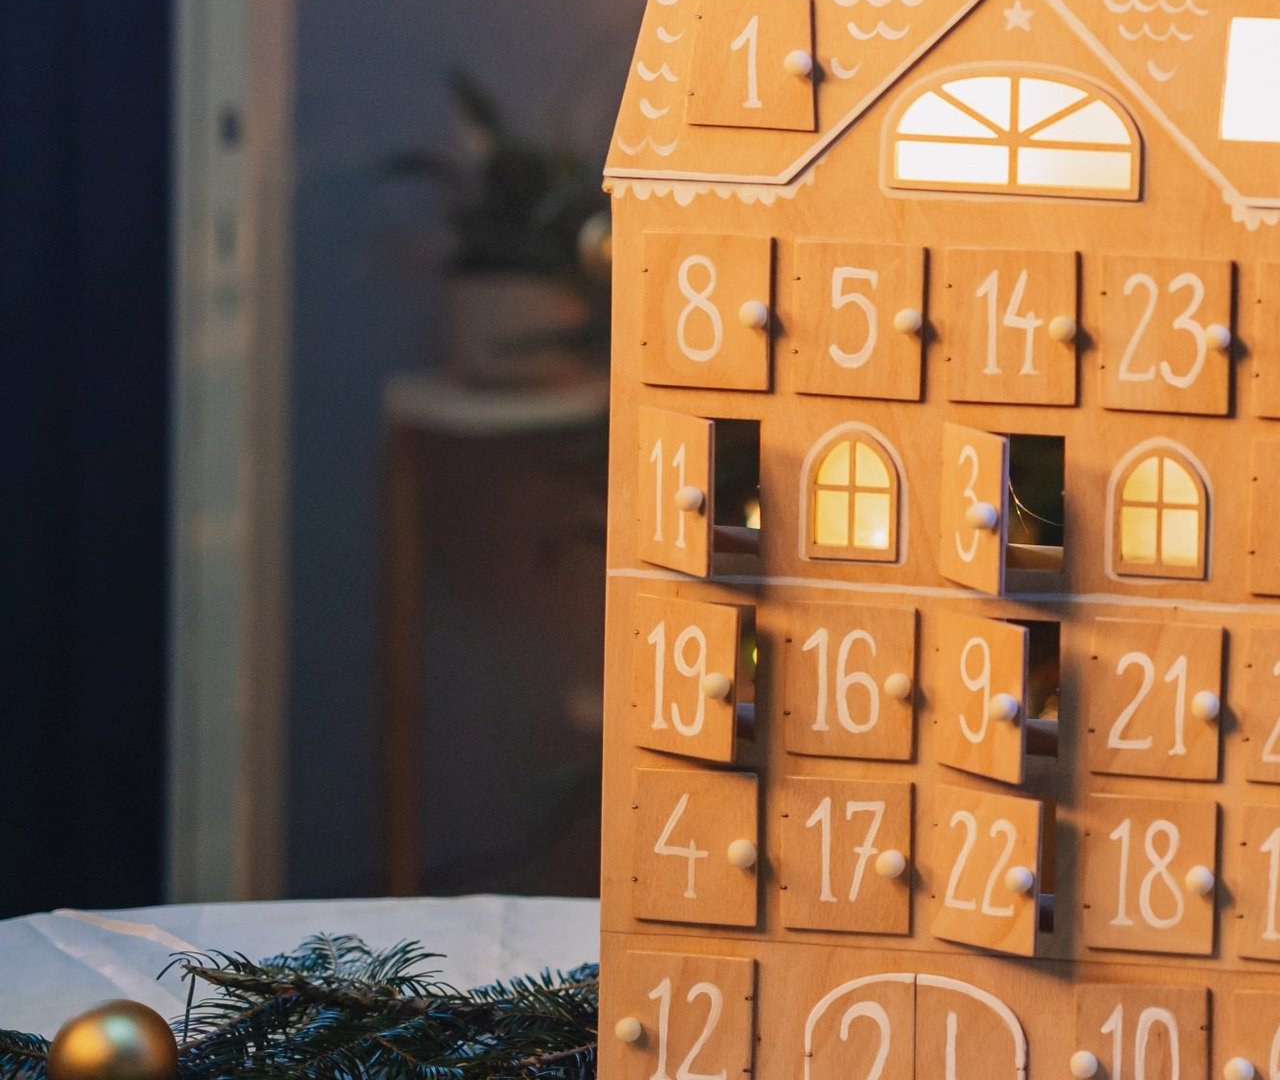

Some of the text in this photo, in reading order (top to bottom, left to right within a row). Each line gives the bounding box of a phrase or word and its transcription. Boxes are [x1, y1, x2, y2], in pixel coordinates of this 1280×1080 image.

[730, 15, 763, 109] 1
[676, 254, 724, 363] 8
[829, 266, 878, 369] 5
[976, 269, 1043, 376] 14
[1118, 272, 1205, 388] 23
[650, 438, 686, 549] 11
[956, 444, 985, 563] 3
[646, 621, 707, 737] 19
[802, 627, 881, 734] 16
[959, 637, 992, 744] 9
[1107, 651, 1188, 756] 21
[654, 792, 709, 899] 4
[806, 795, 886, 902] 17
[944, 810, 1017, 917] 22
[1108, 818, 1185, 929] 18
[648, 976, 728, 1080] 12
[1100, 1003, 1180, 1080] 10
